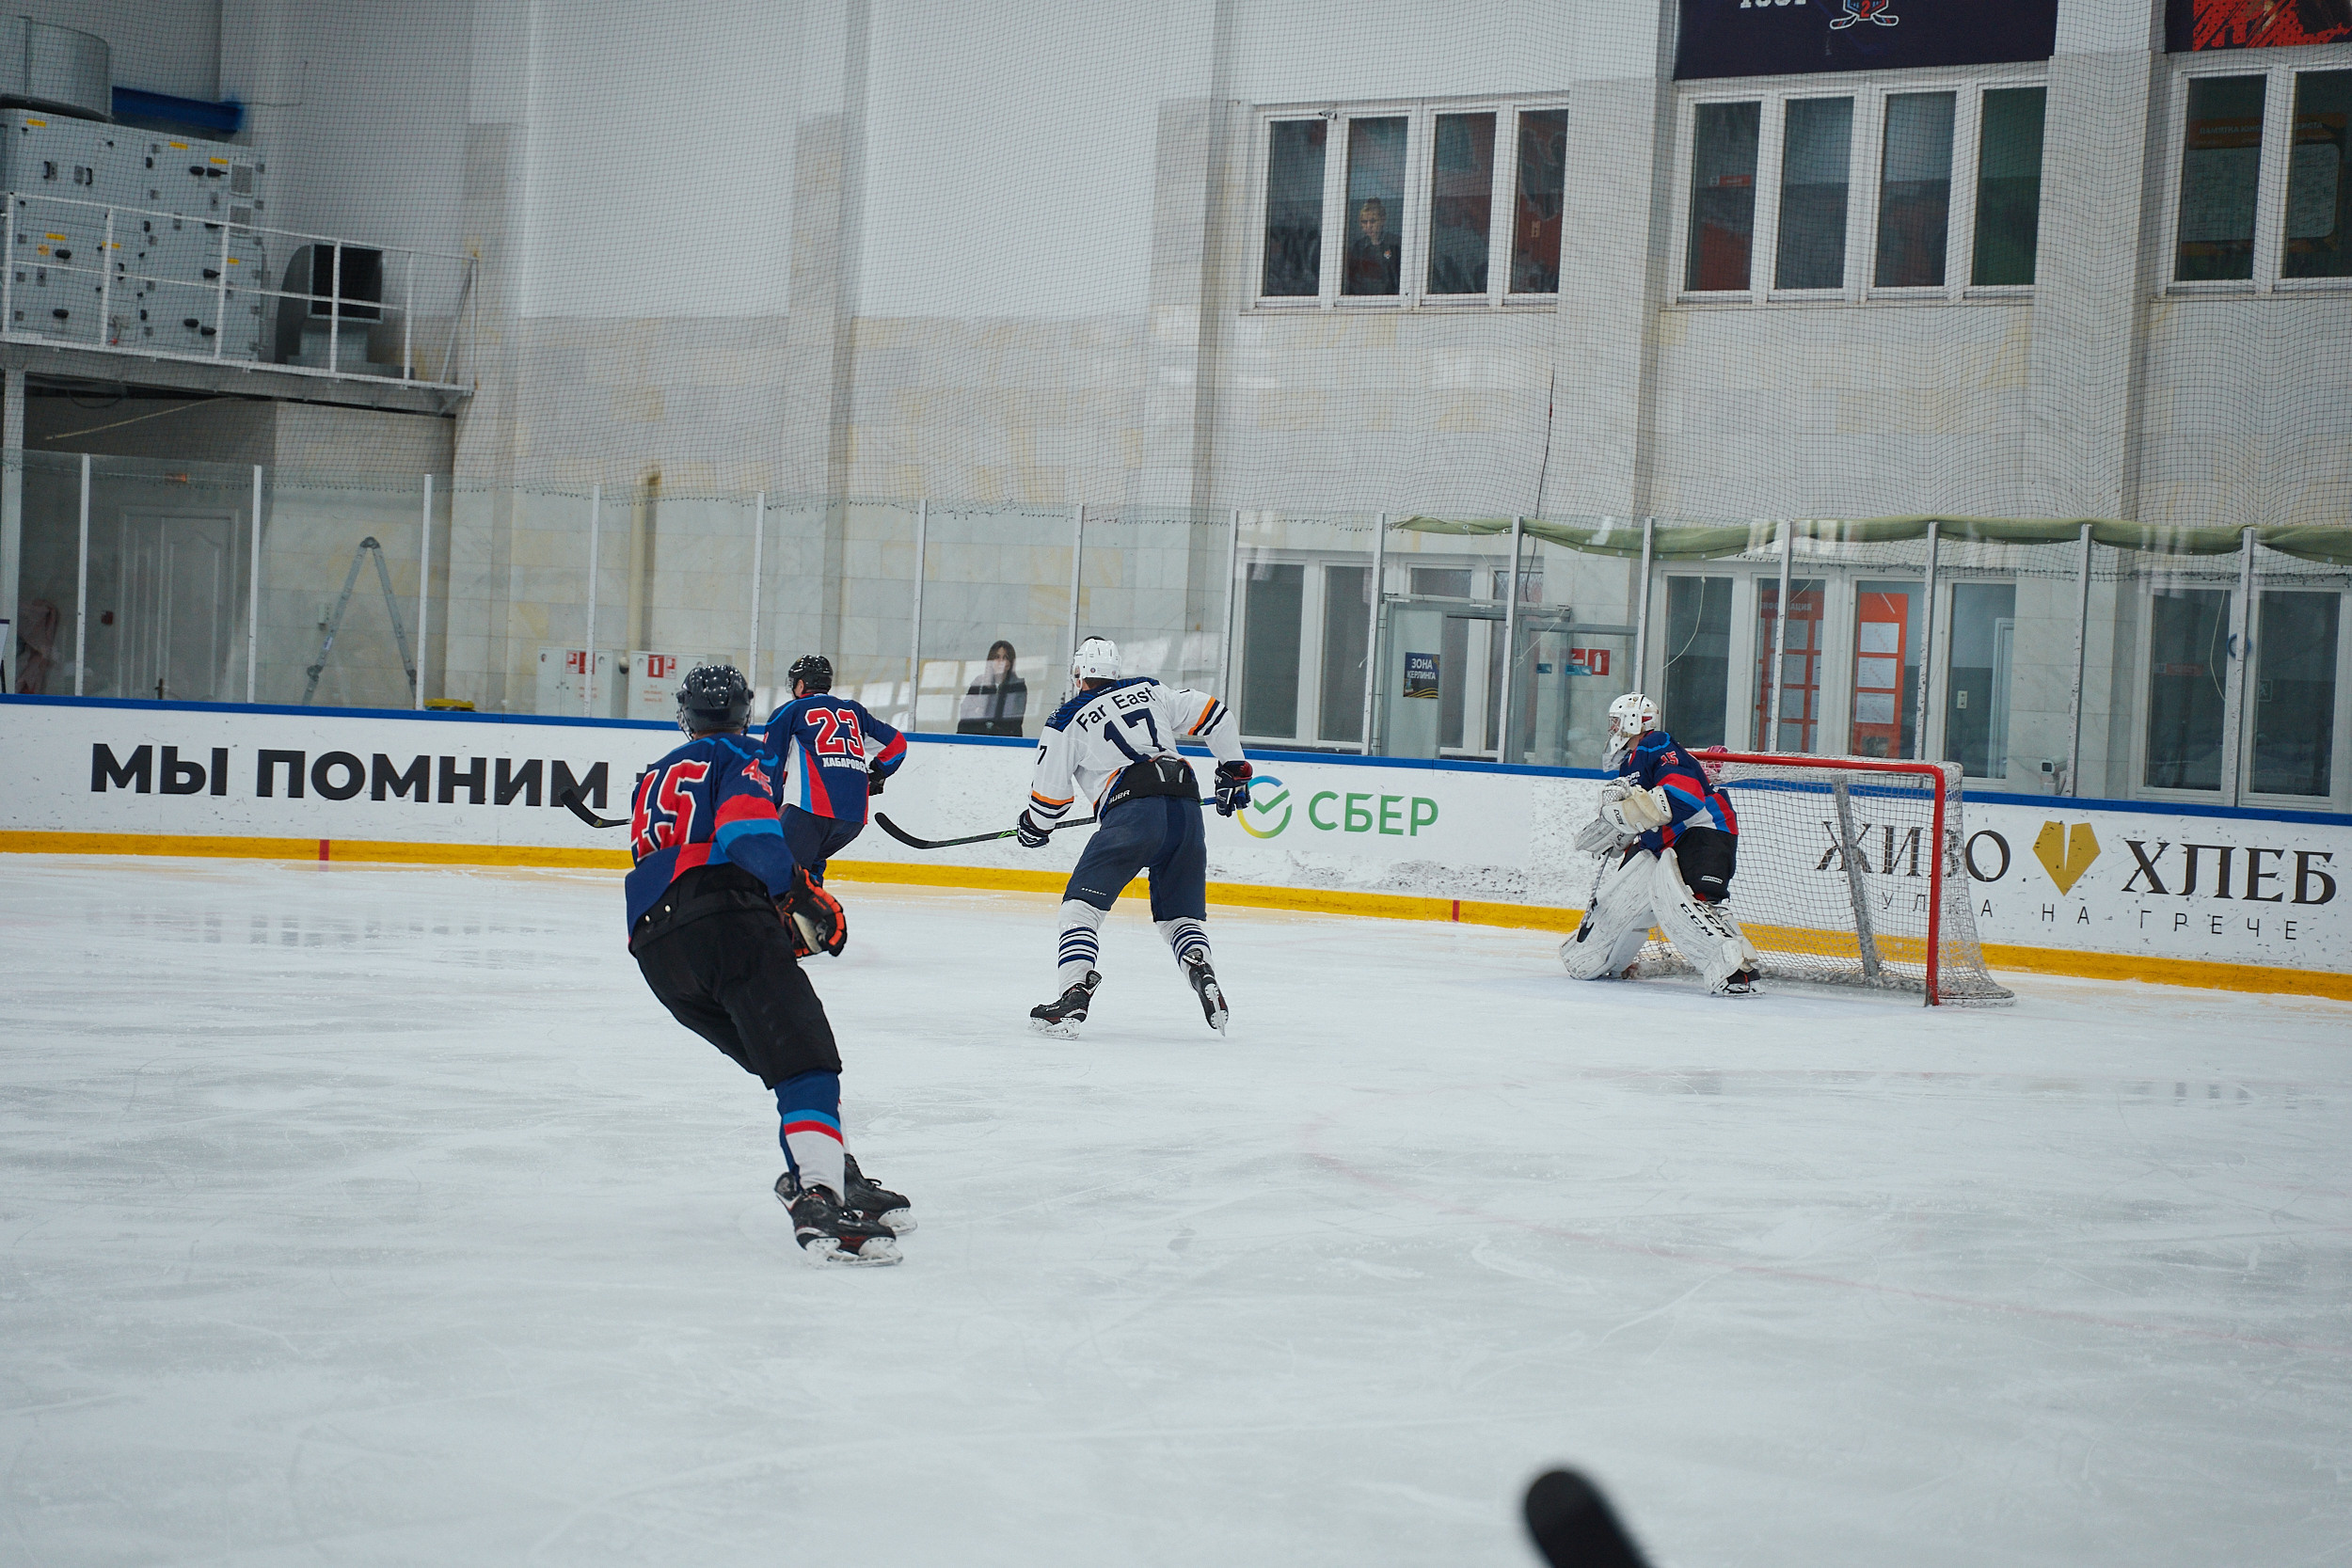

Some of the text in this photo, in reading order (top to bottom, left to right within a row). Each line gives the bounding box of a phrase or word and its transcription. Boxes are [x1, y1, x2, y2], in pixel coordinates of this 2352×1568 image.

[1406, 670, 1437, 680] КЕРЛИНГА
[1411, 658, 1433, 670] ЗОНА
[804, 707, 865, 759] 23
[1075, 687, 1157, 733] Far East
[1103, 707, 1168, 763] 17
[91, 743, 609, 809] МЫ ПОМНИМ
[630, 759, 711, 863] 45
[1309, 790, 1439, 836] СБЕР
[2121, 840, 2337, 905] ХЛЕБ
[1679, 902, 1715, 937] CCM
[1692, 901, 1734, 939] CCM
[2042, 903, 2090, 925] НА
[2139, 910, 2297, 941] ГРЕЧЕ
